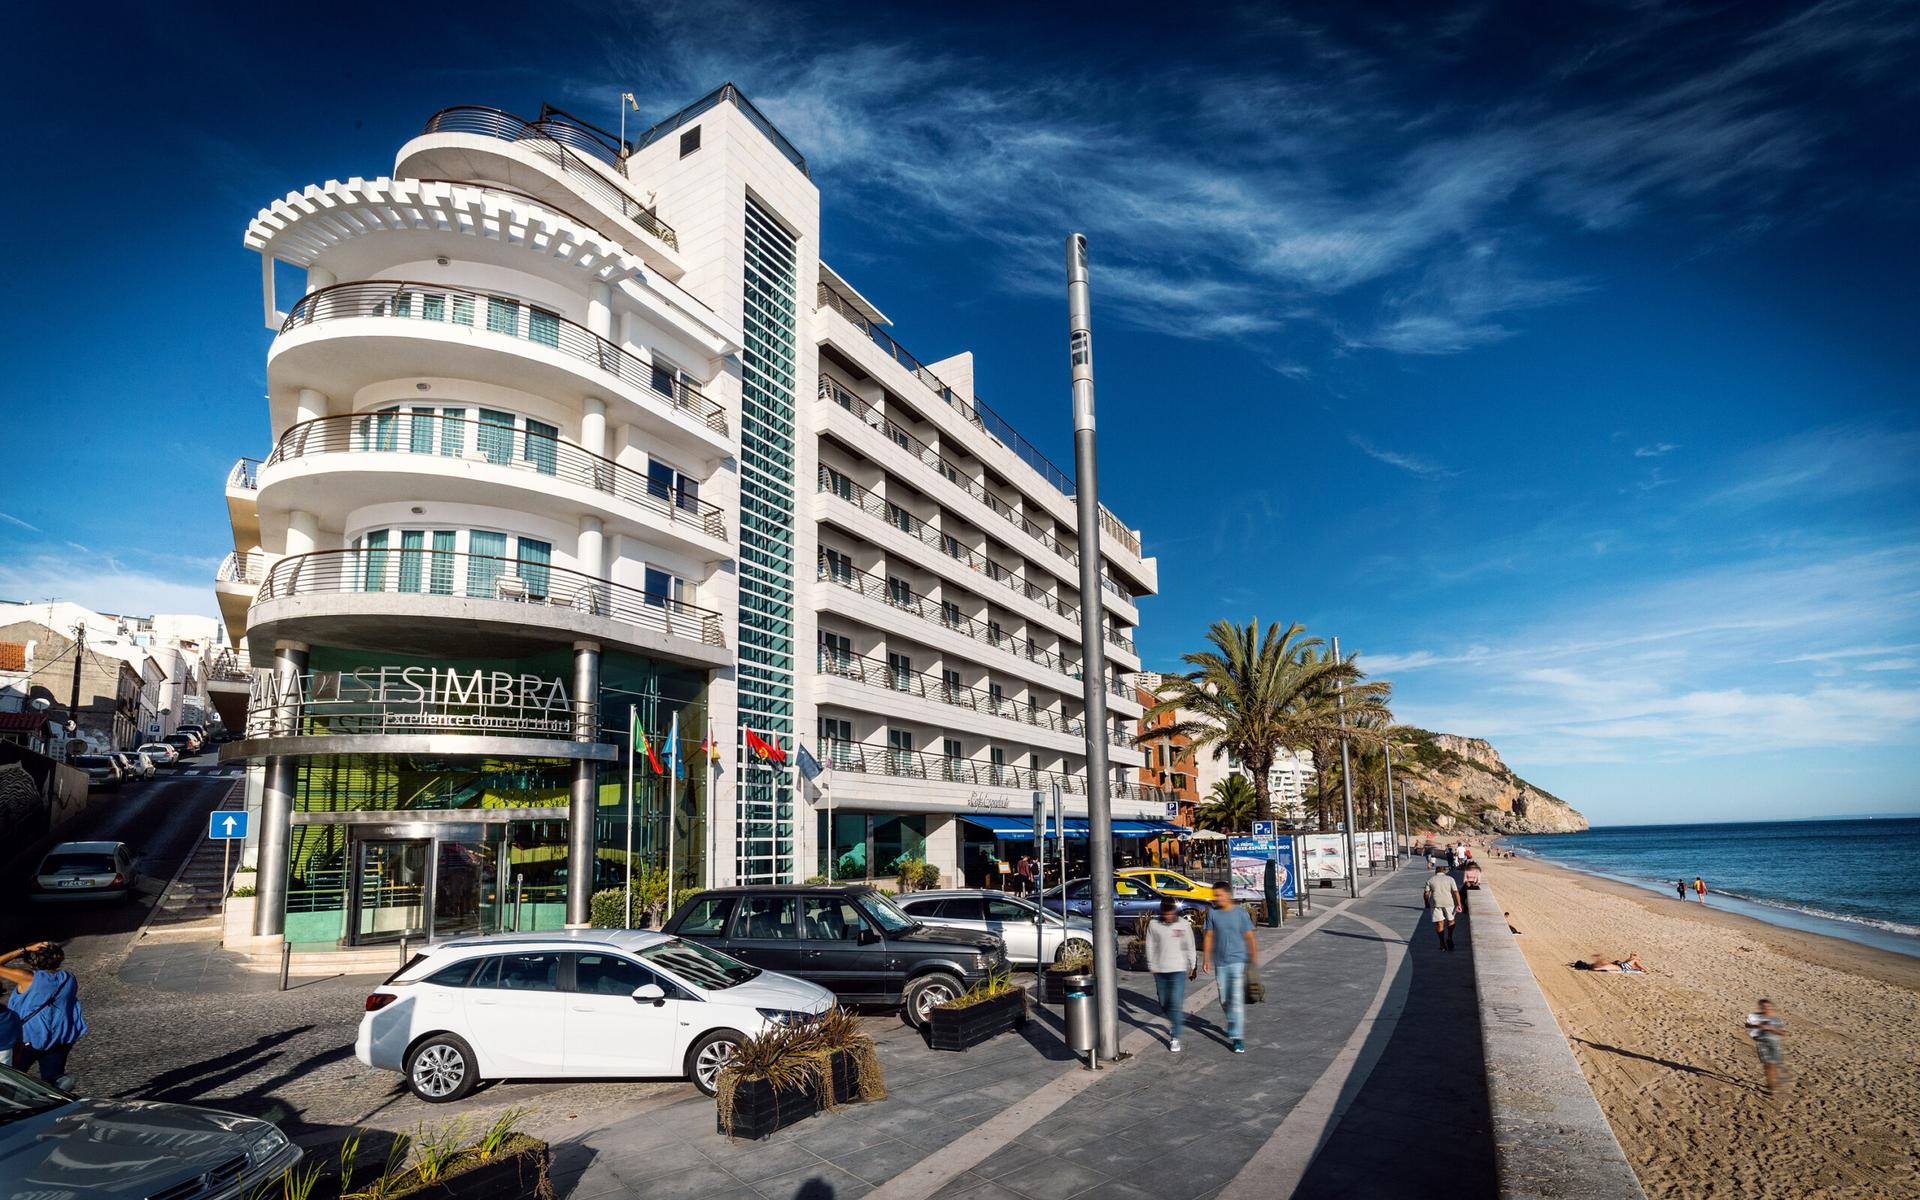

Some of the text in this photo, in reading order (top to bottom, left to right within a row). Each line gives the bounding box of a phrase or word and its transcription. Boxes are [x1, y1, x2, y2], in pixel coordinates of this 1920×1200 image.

[352, 665, 571, 712] SESIMBRA
[386, 711, 465, 727] Excellence
[1254, 824, 1263, 834] P
